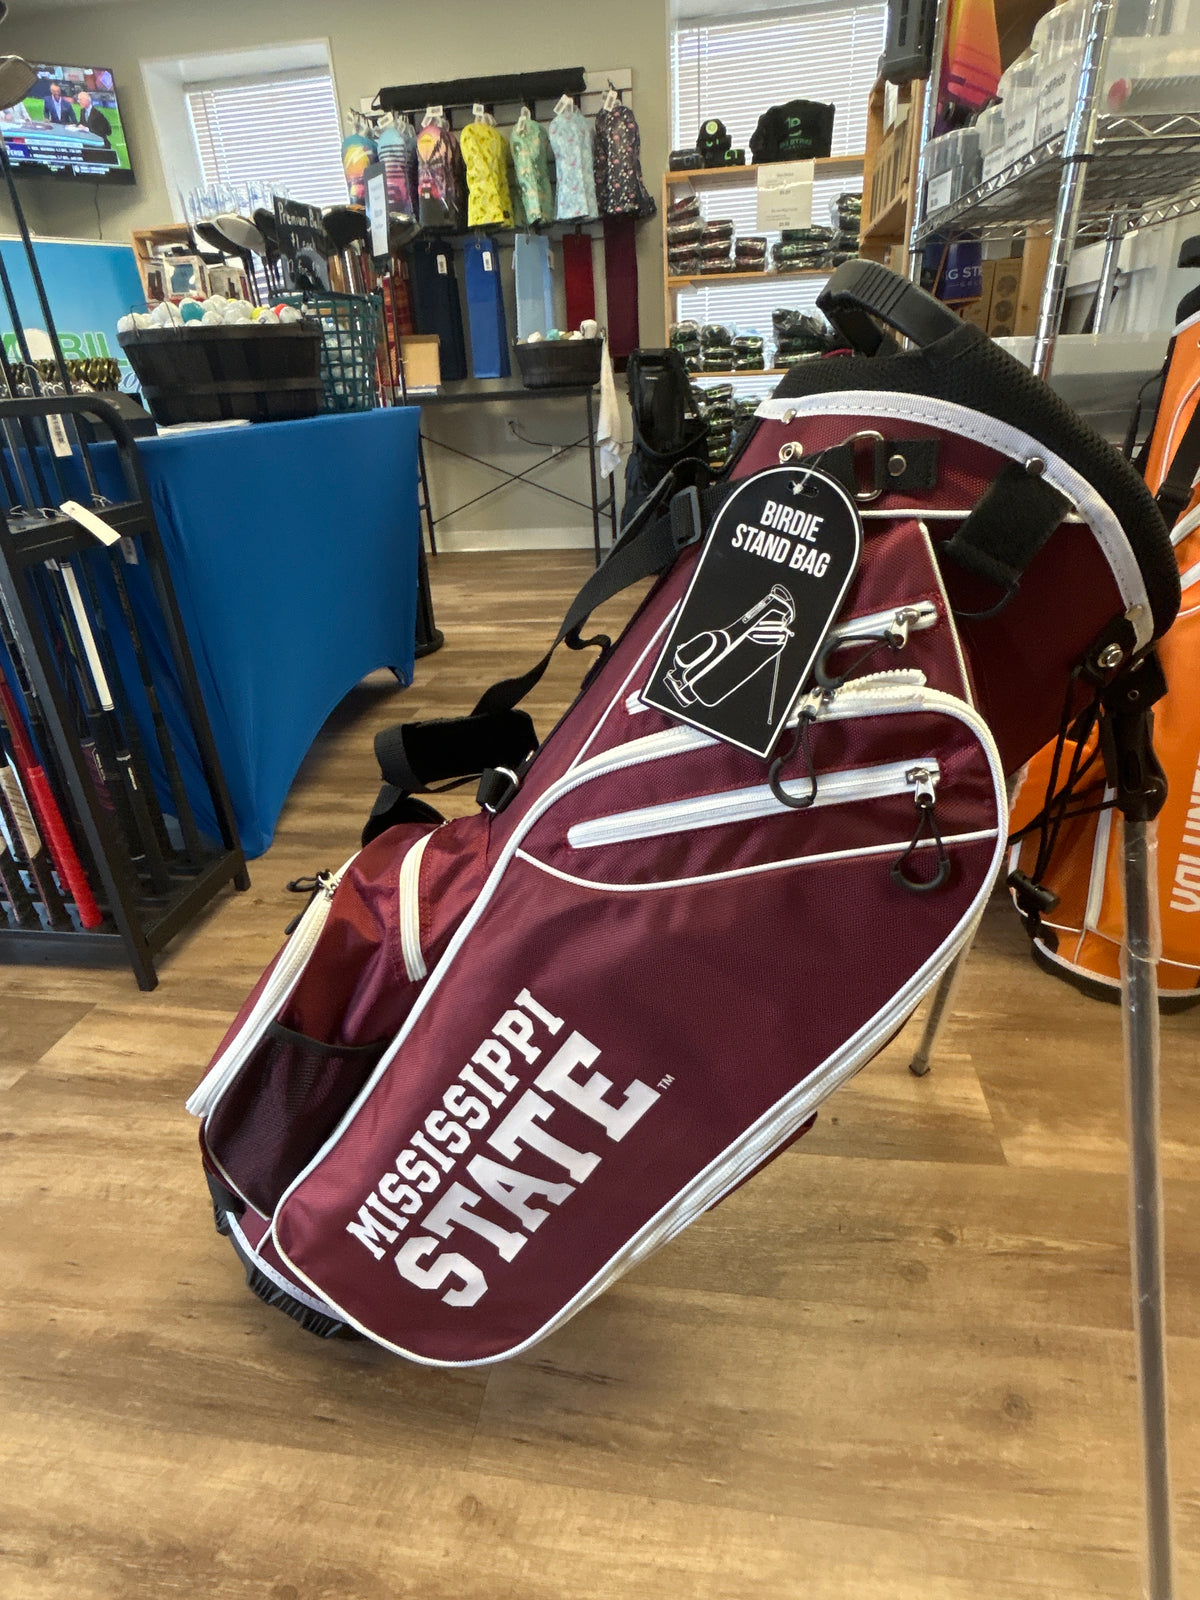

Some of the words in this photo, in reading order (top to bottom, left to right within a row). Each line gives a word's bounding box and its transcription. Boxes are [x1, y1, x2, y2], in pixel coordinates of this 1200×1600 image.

[731, 523, 791, 564] STAND
[788, 543, 831, 578] BAG
[760, 500, 824, 543] BIRDIE
[346, 987, 565, 1261] MISSISSIPPI
[393, 1030, 661, 1308] STATE
